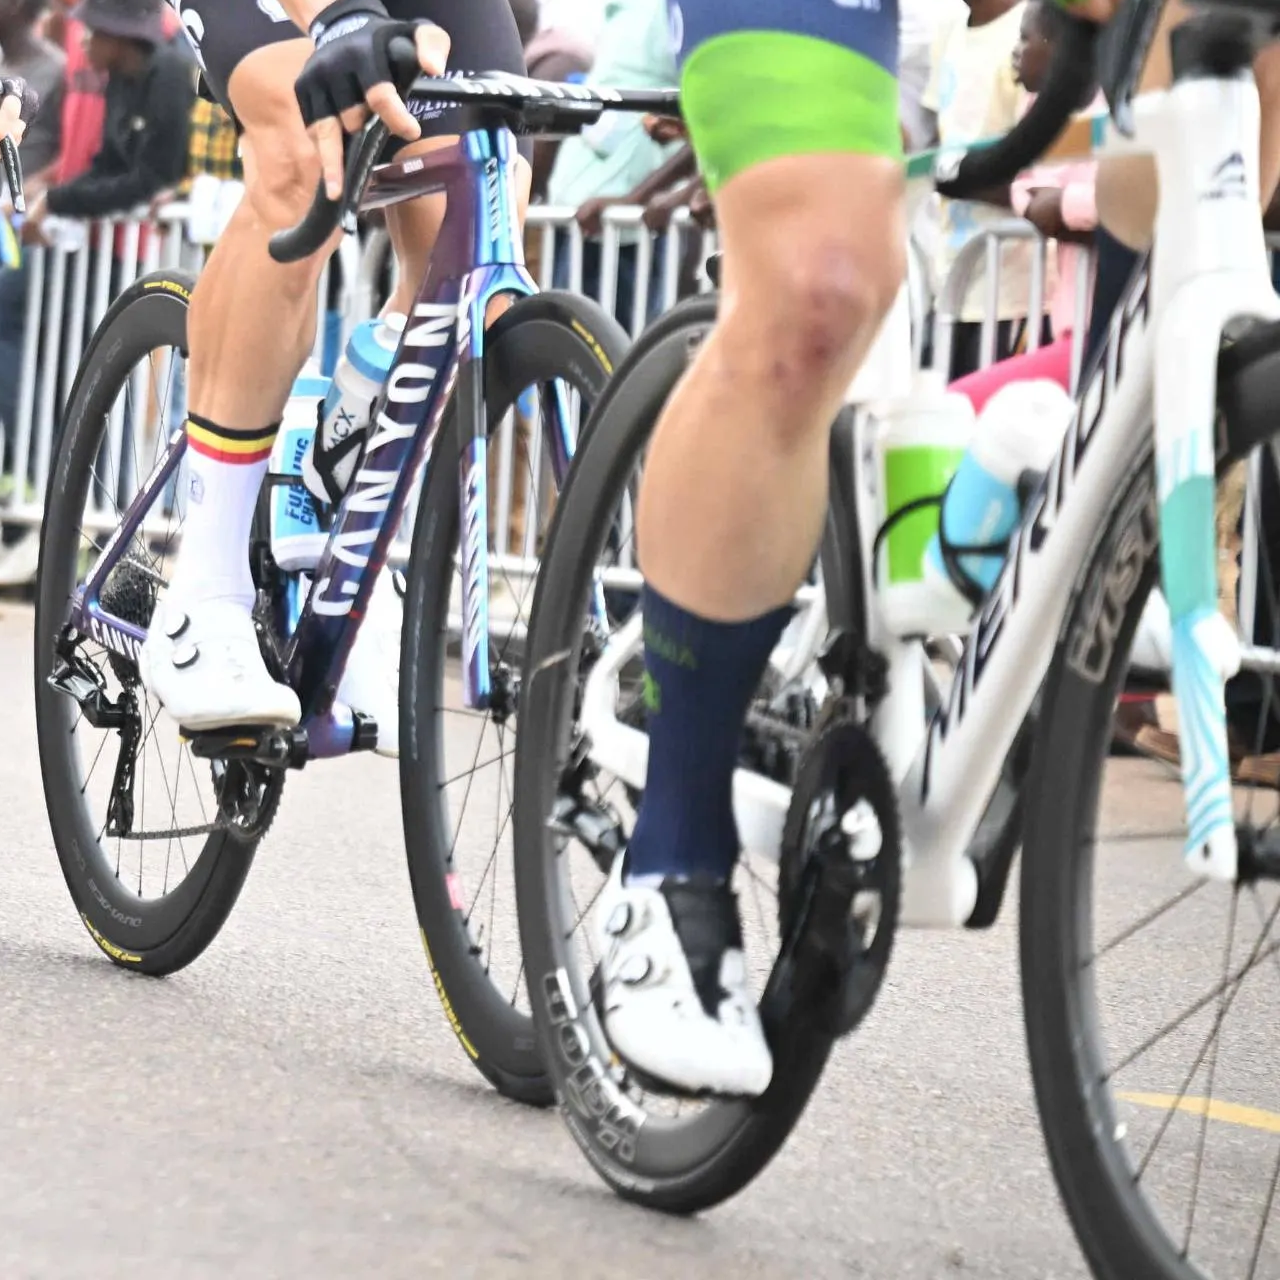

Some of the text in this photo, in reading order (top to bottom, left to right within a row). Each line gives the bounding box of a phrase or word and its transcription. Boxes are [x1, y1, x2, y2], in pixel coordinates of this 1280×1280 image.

[161, 279, 192, 300] PIRELL
[311, 302, 456, 616] CANYON
[90, 616, 142, 662] CANYO
